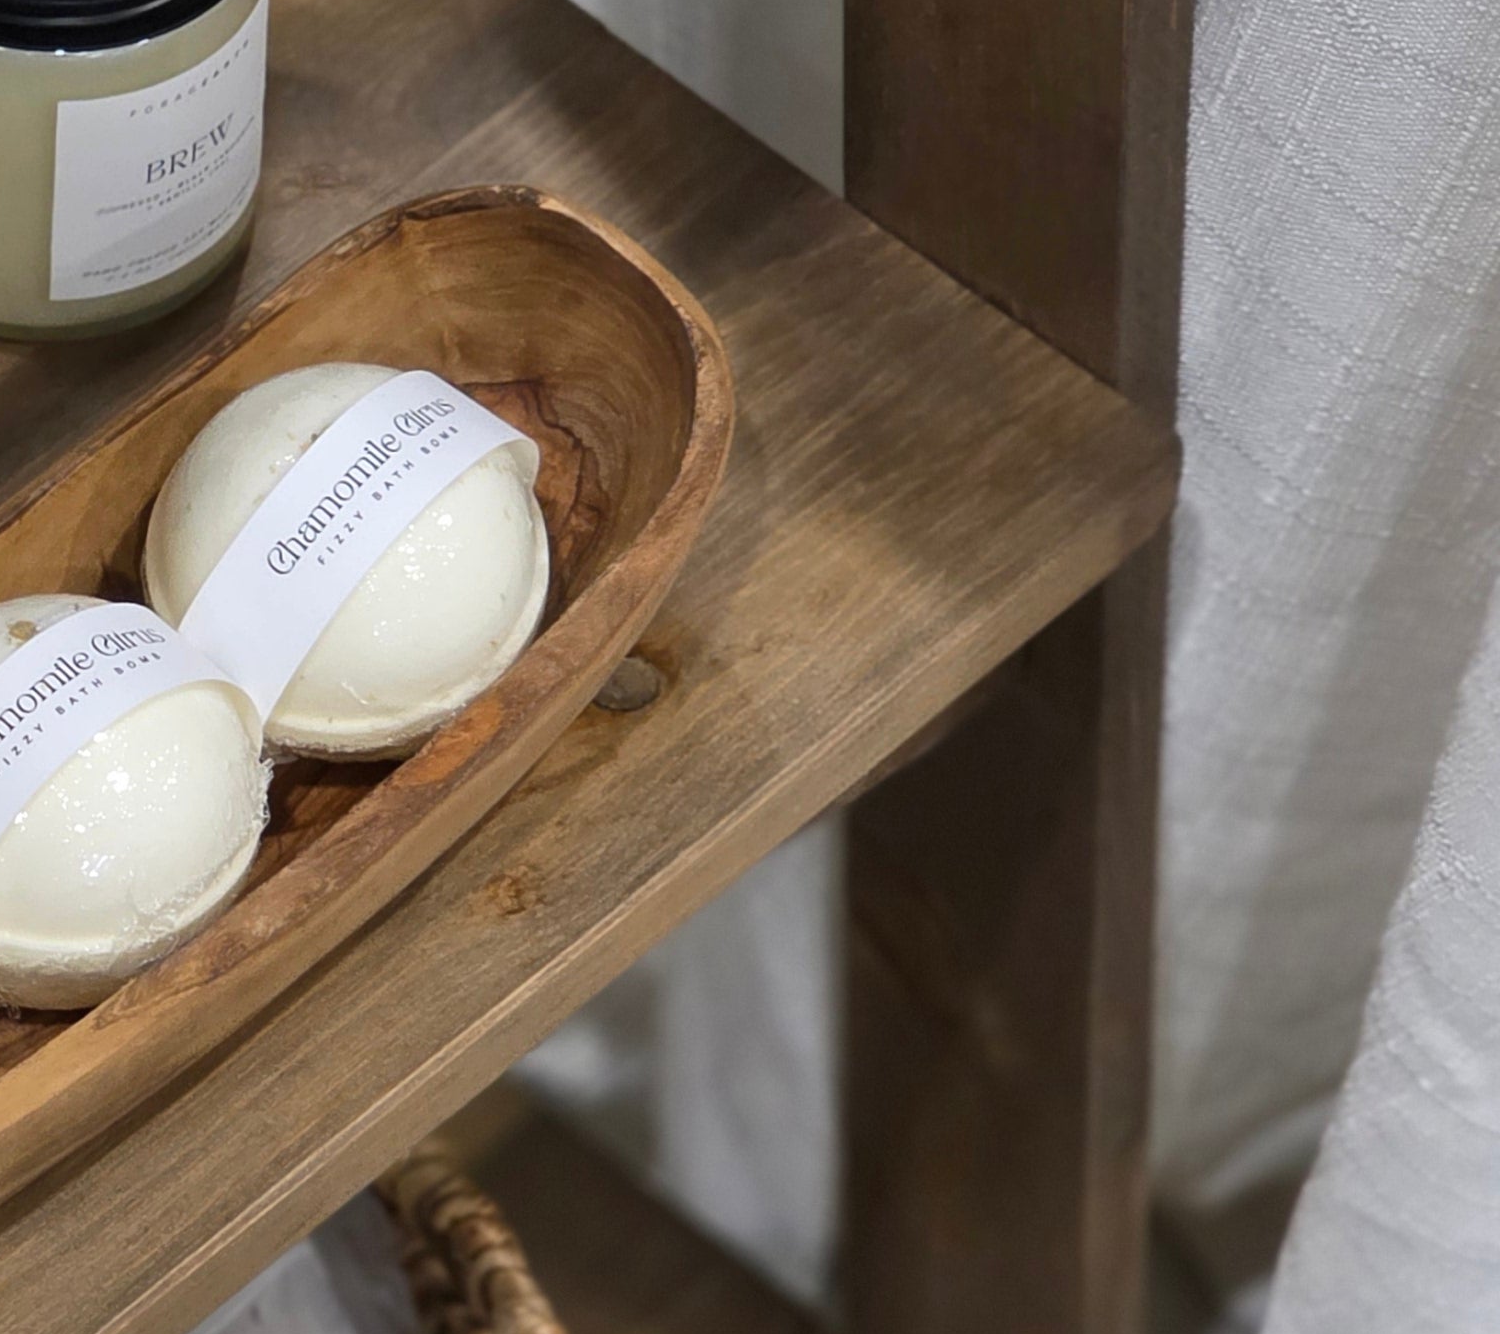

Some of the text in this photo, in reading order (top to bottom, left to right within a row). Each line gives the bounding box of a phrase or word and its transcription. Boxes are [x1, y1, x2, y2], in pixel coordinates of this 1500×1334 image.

[146, 113, 235, 185] BREW
[266, 397, 456, 575] Chamomile Citrus
[317, 425, 459, 566] FIZZY BATH BOMB
[91, 627, 167, 657] Citrus
[55, 678, 103, 716] BATH
[114, 652, 161, 675] BOMB
